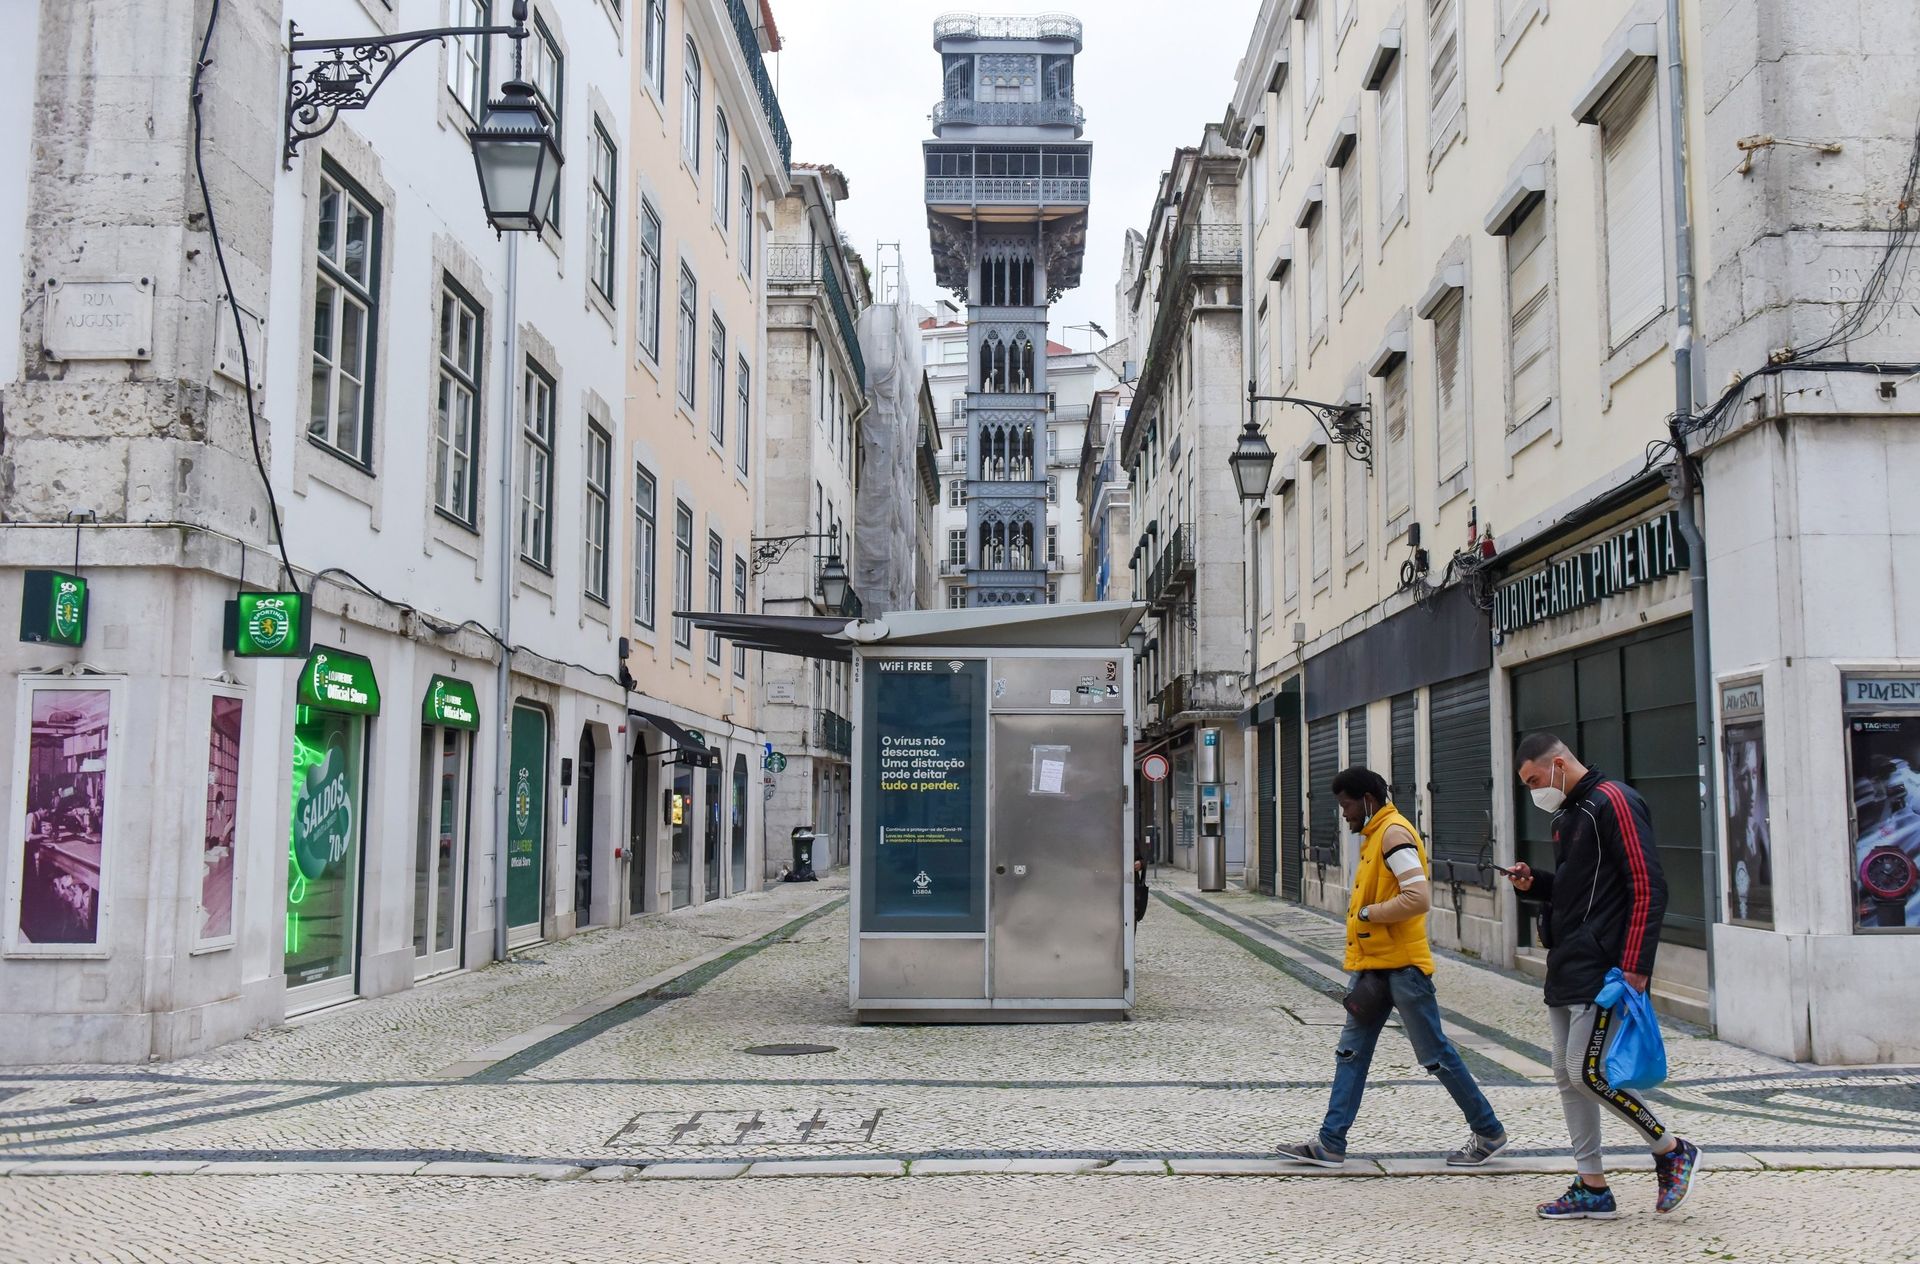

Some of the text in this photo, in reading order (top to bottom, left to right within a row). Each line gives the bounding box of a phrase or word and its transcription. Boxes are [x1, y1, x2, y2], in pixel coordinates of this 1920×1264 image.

[82, 293, 115, 307] RUA
[1493, 511, 1676, 635] OURIVESARIA PIMENTA
[256, 598, 285, 609] SCP
[253, 609, 284, 621] SPORTING
[879, 661, 933, 671] WiFi FREE
[881, 735, 946, 746] O vírus não
[881, 747, 940, 757] descansa.
[881, 757, 965, 771] Uma distração
[881, 769, 948, 781] pode deitar
[881, 780, 960, 792] tudo a perder.
[303, 772, 345, 839] SALDOS
[1588, 1029, 1606, 1057] SUPER
[1593, 1080, 1619, 1100] SUPER
[1636, 1108, 1657, 1131] SUPER
